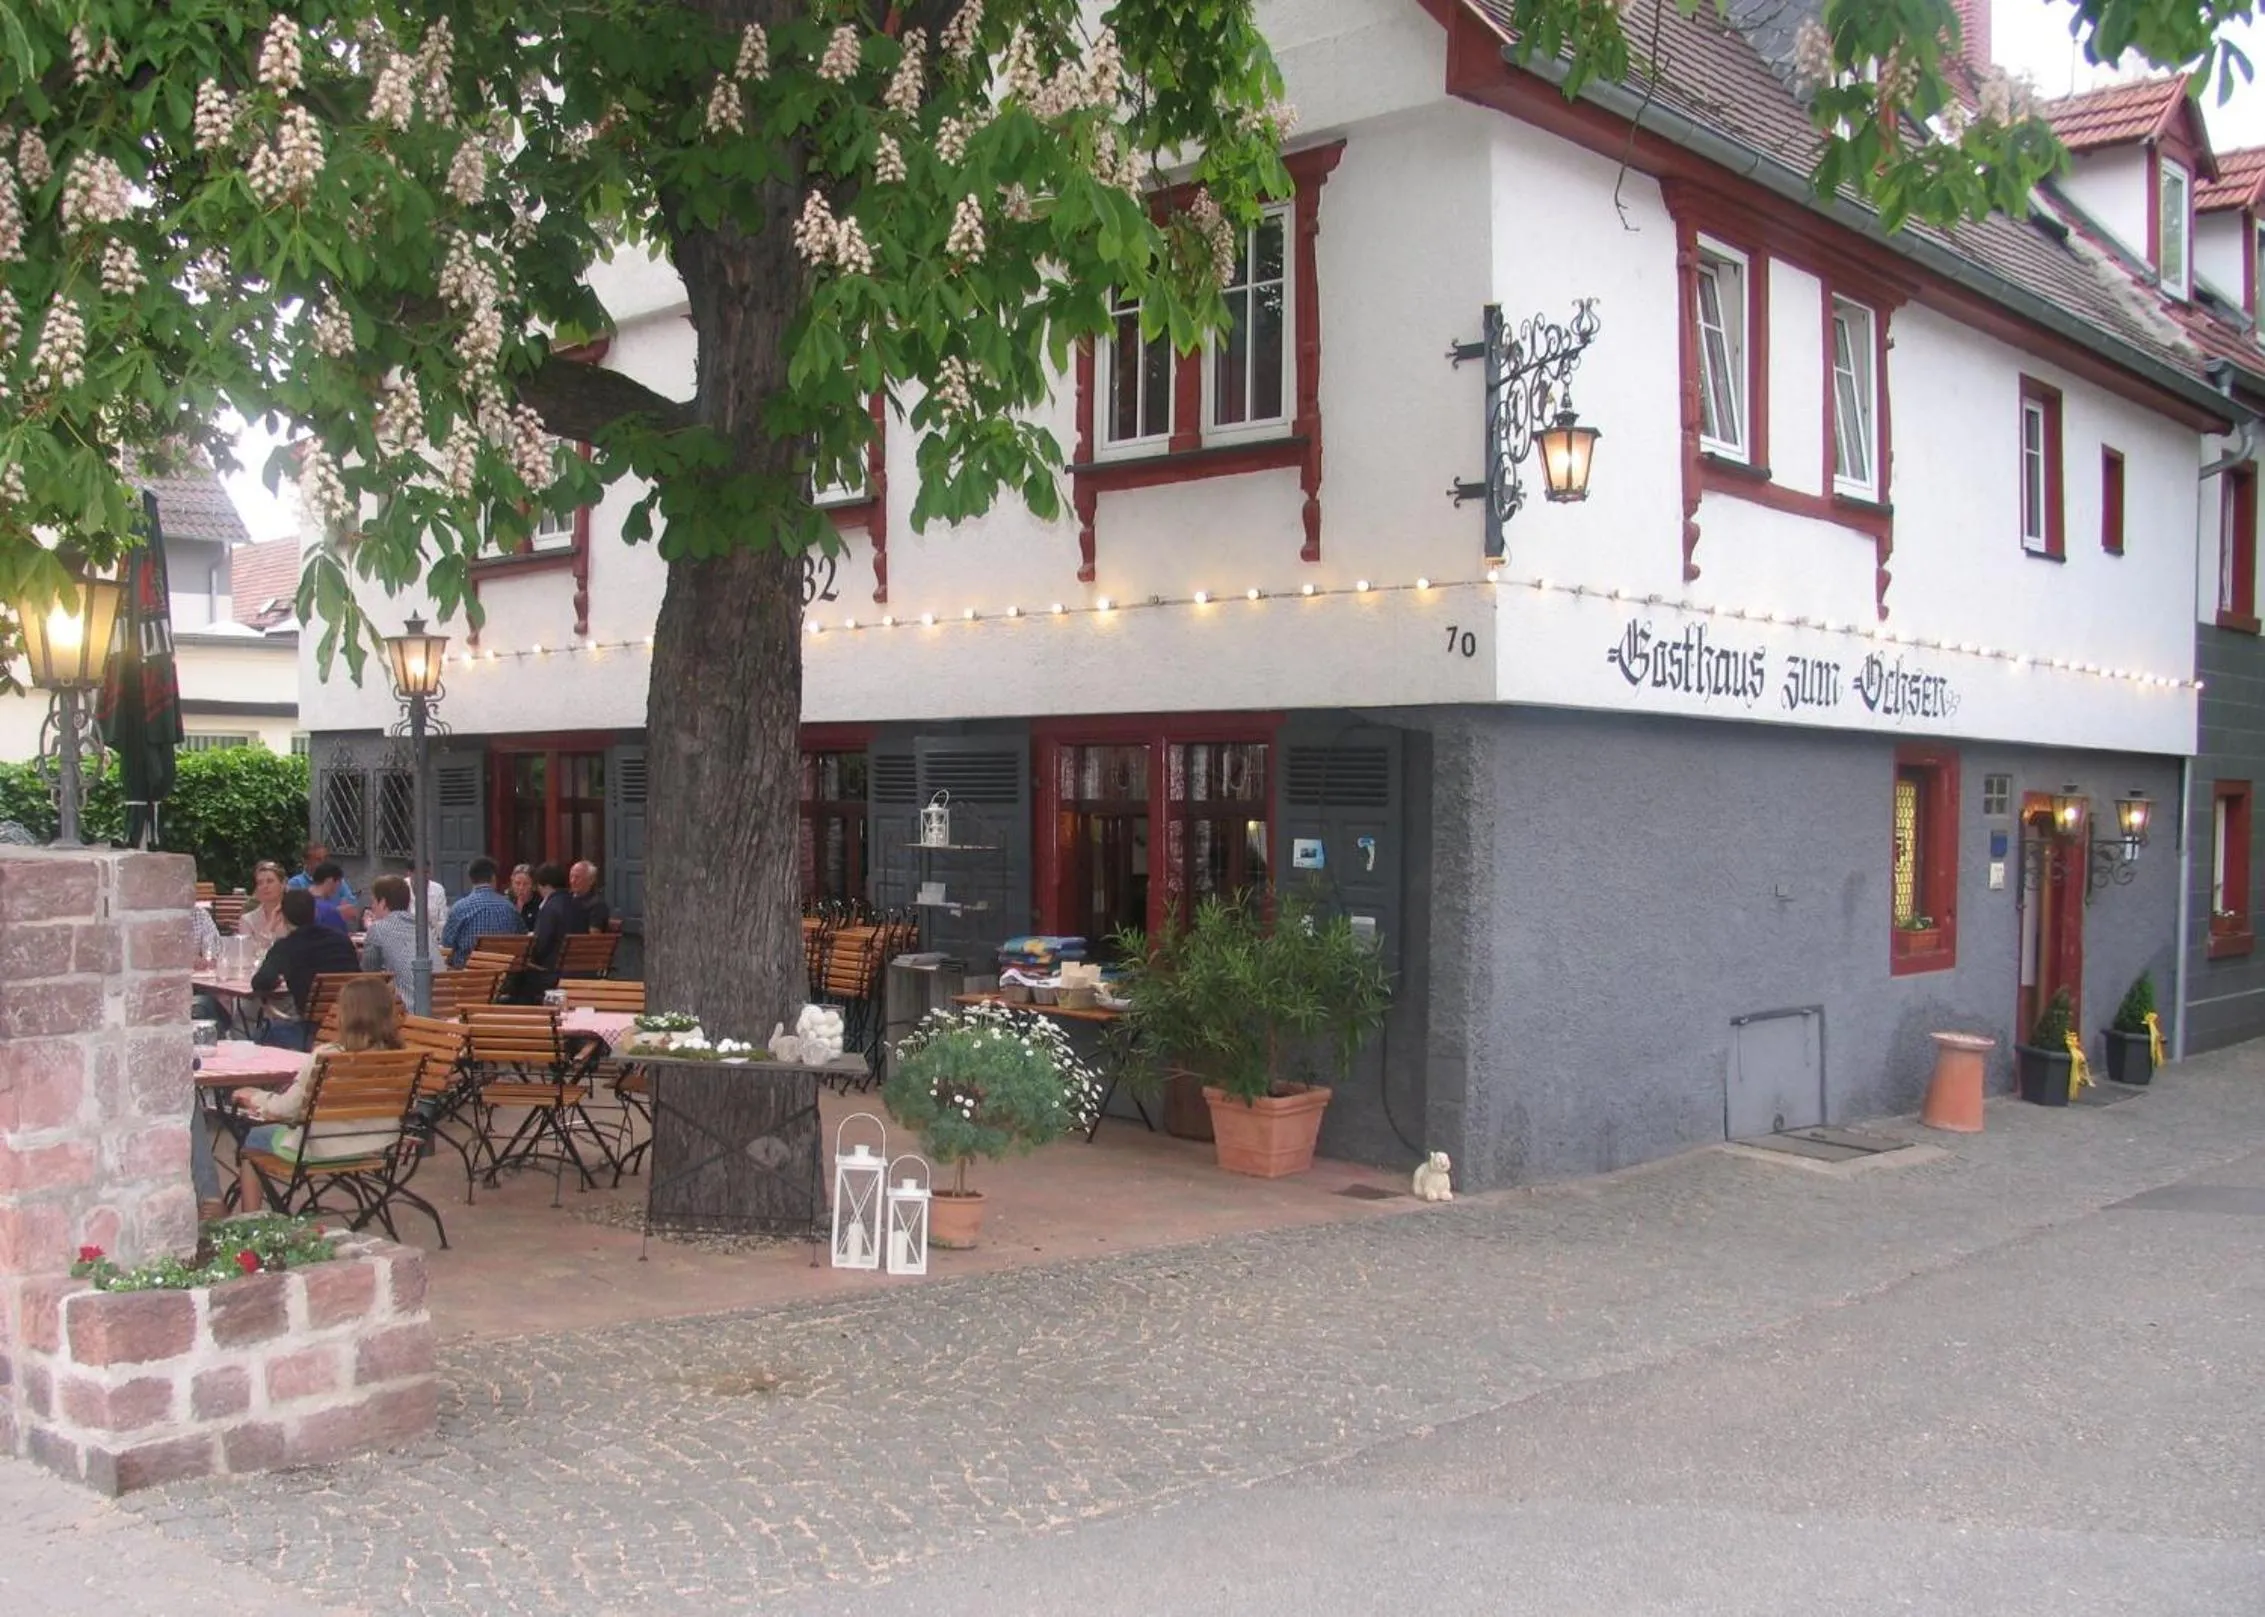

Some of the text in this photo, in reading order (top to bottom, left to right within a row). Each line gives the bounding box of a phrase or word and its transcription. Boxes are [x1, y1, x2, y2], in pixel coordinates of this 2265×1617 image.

[1445, 625, 1476, 658] 70
[1608, 618, 1957, 724] Gasthaus zum Ochsen
